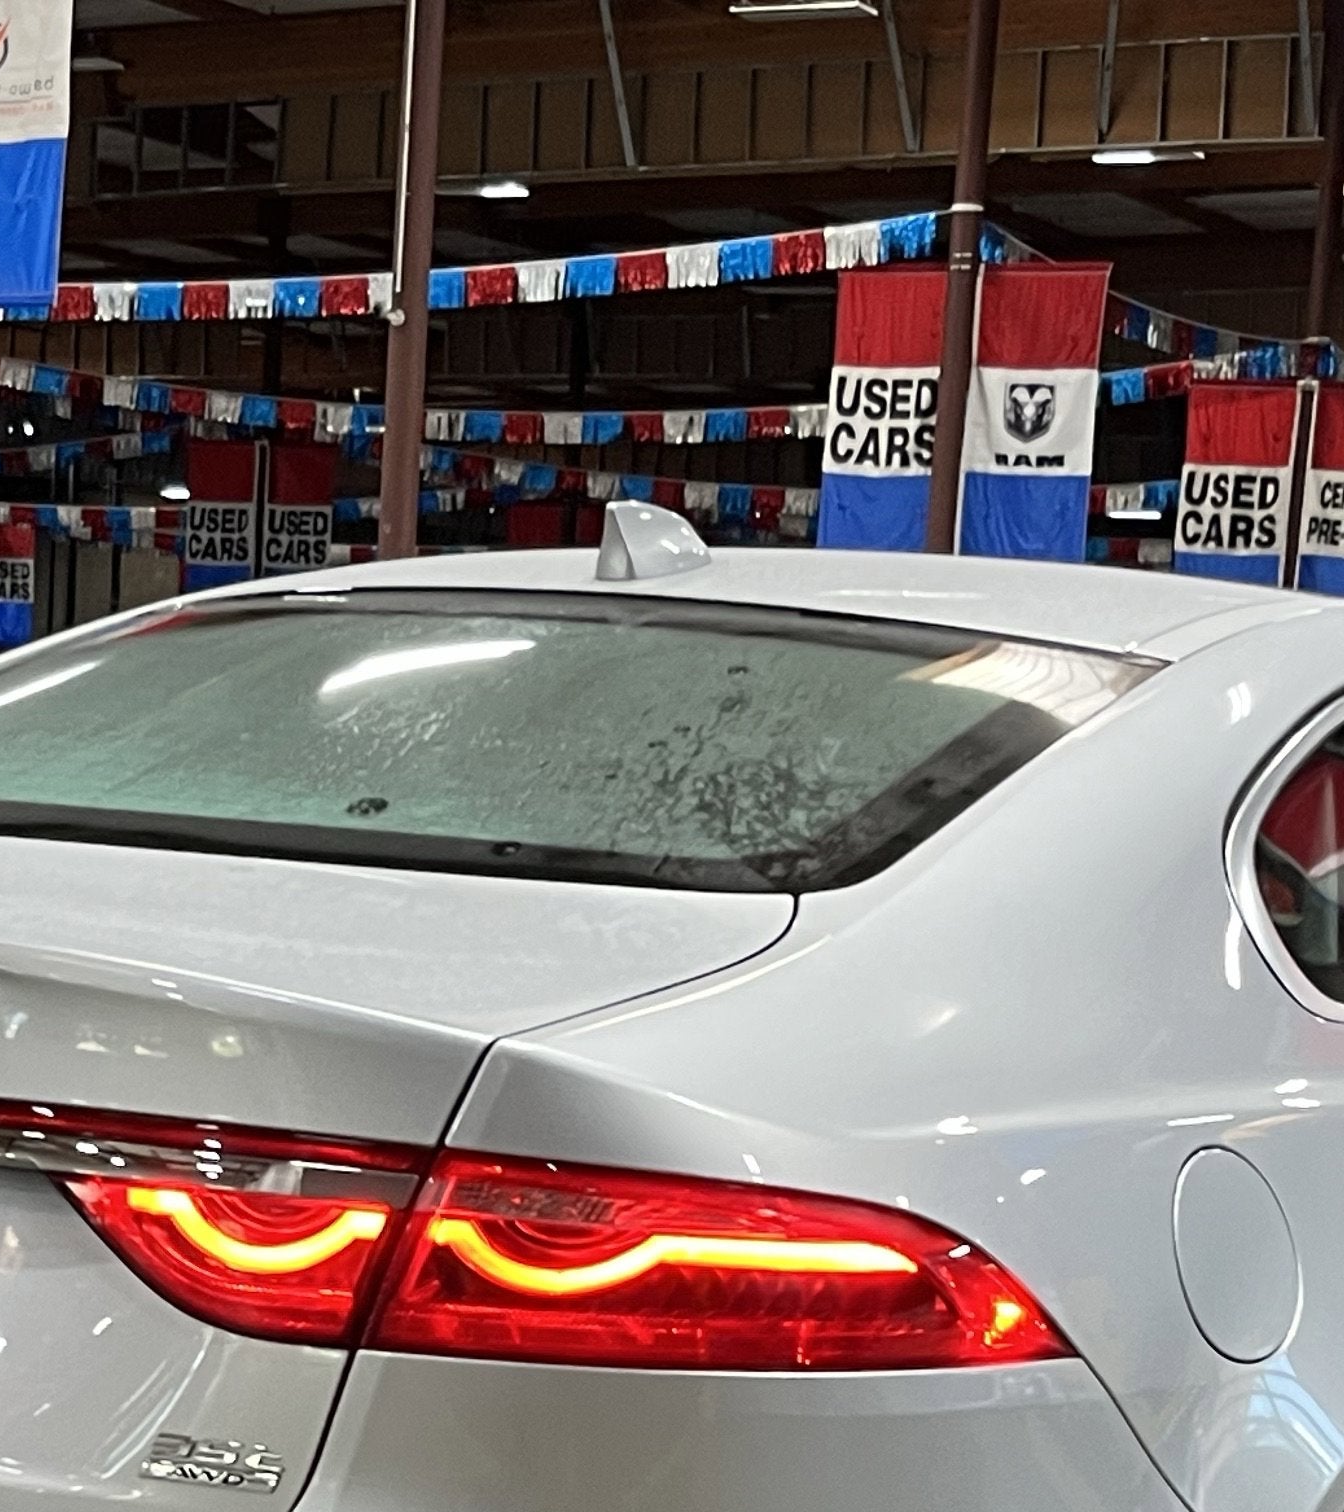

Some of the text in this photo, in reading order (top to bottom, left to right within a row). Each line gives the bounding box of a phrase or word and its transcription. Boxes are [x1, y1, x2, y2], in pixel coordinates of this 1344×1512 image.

[835, 376, 939, 421] USED
[829, 422, 936, 469] CARS
[1183, 471, 1281, 510] USED
[189, 504, 249, 533] USED
[267, 509, 329, 537] USED
[1181, 510, 1277, 549] CARS
[188, 533, 249, 562] CARS
[265, 537, 328, 565] CARS
